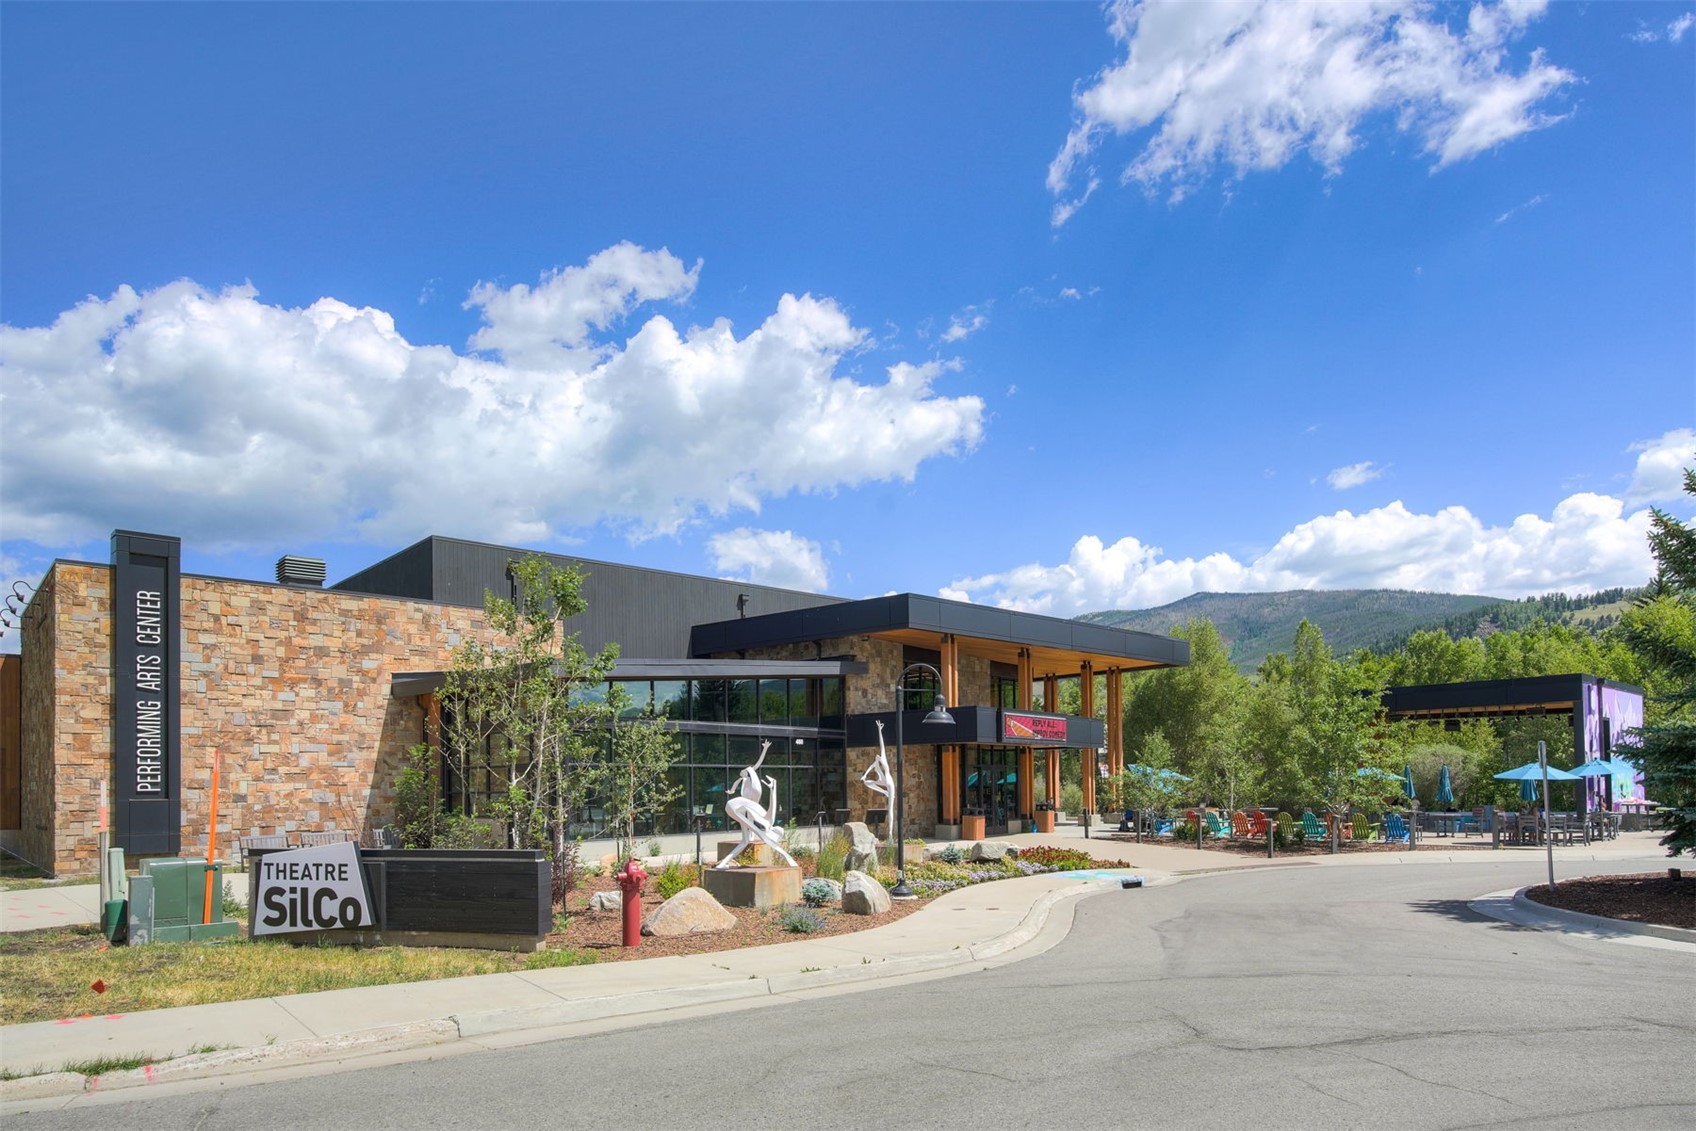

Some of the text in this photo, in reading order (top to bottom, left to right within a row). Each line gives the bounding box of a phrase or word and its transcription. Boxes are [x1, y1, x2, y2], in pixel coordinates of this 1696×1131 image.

[136, 590, 161, 792] PERFORMING ARTS CENTER
[263, 862, 349, 881] THEATRE
[262, 886, 362, 928] SilCo
